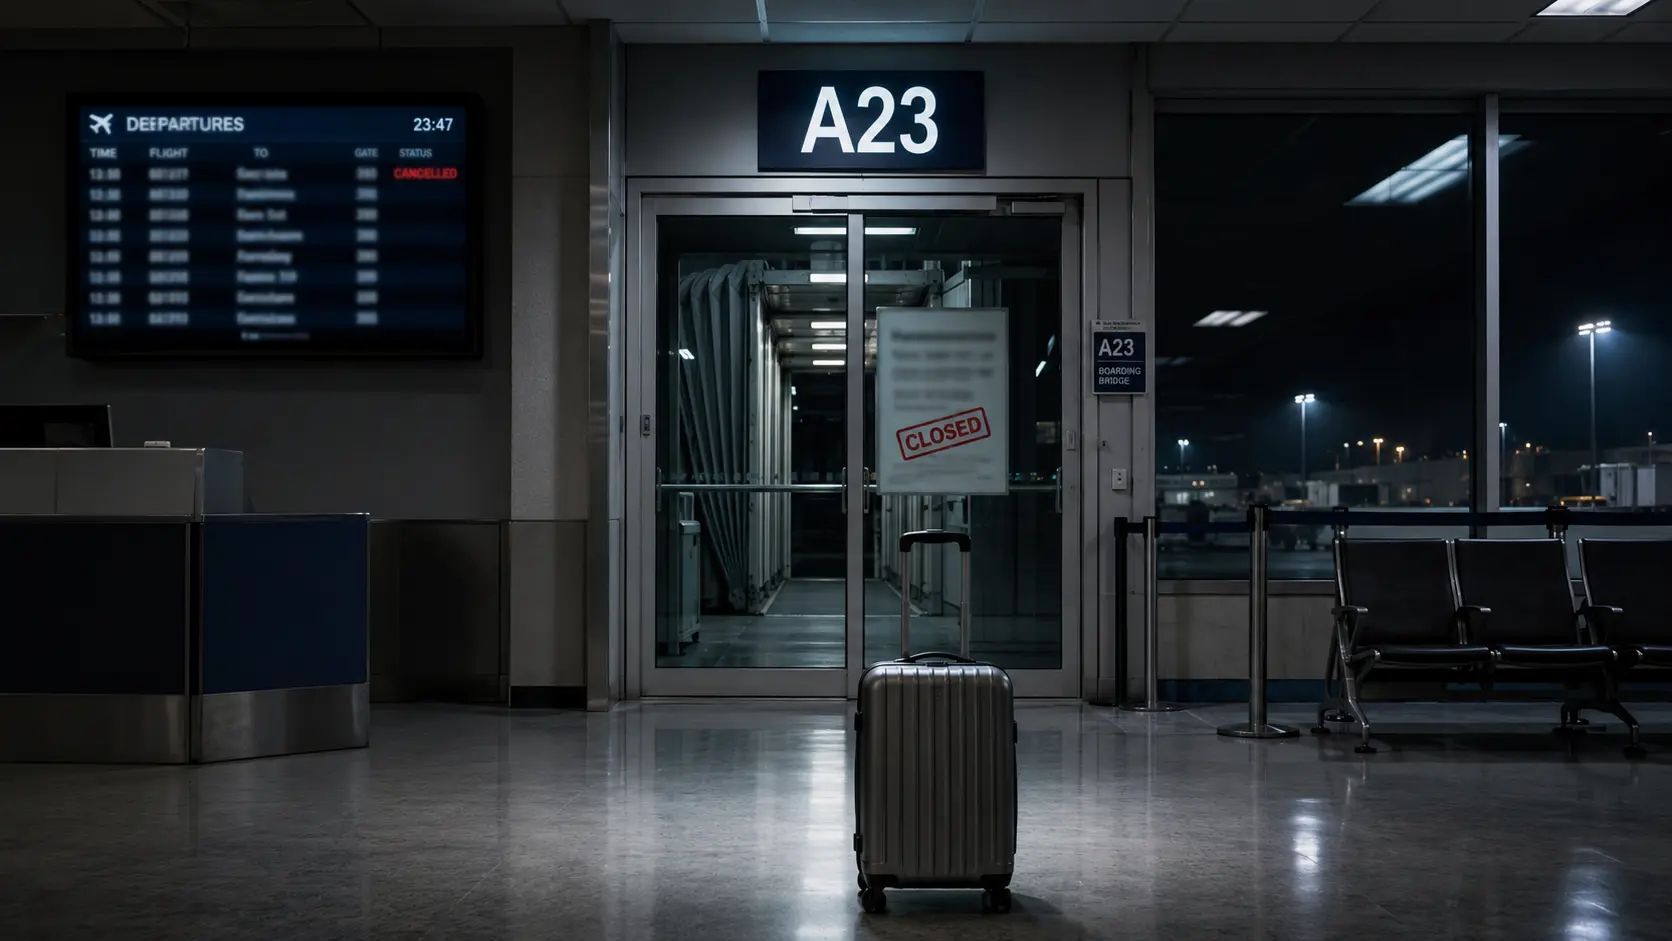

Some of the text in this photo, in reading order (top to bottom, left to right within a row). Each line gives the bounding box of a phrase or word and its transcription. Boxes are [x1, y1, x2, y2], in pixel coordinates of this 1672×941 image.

[413, 117, 453, 131] 23:47
[801, 86, 939, 154] A23
[89, 148, 433, 158] TIME FLIGHT TO GATE STATUS
[393, 167, 458, 180] CANCELLED
[1098, 338, 1134, 356] A23
[1098, 367, 1141, 375] BOARDING
[1098, 377, 1130, 385] BRIDGE
[905, 416, 982, 452] CLOSED
